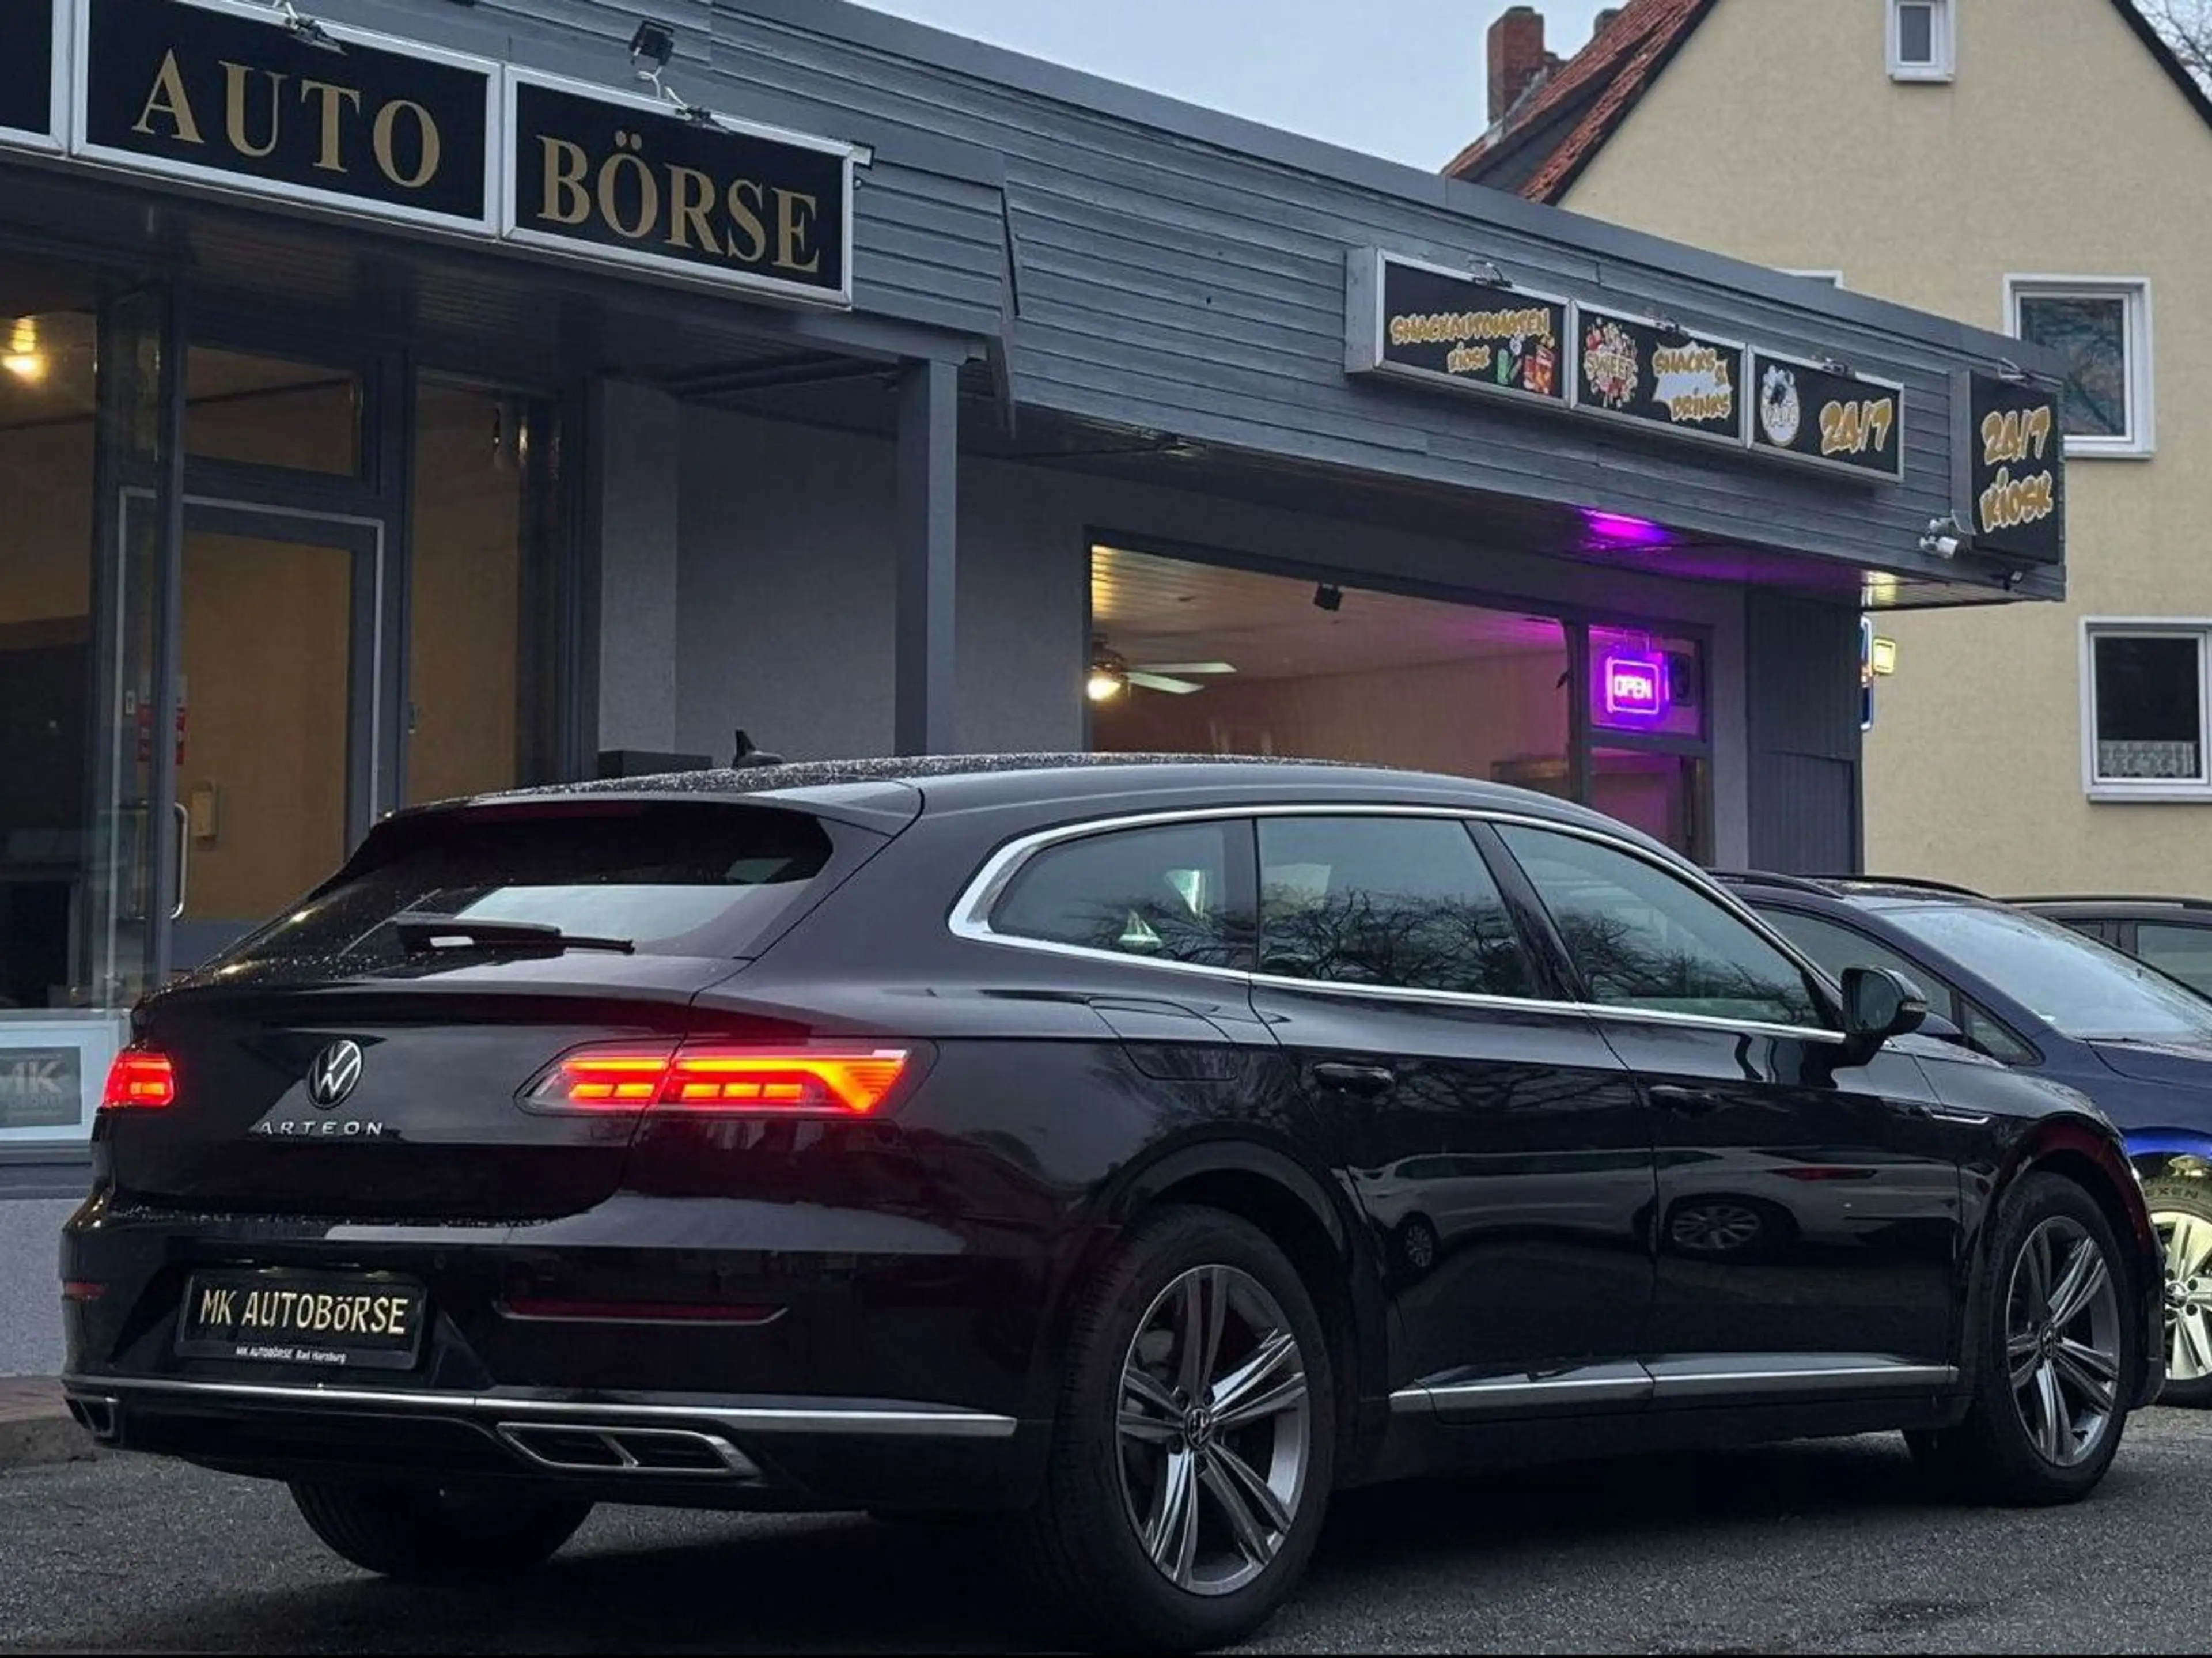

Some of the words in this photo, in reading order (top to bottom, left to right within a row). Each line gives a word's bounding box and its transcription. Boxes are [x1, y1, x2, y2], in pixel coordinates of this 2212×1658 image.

[131, 48, 441, 188] AUTO
[536, 129, 819, 273] BÖRSE
[1652, 347, 1717, 377] SNACKS
[1819, 398, 1892, 455] 24/7
[1982, 406, 2050, 464] 24/7
[1979, 466, 2053, 532] KIOSK
[1613, 674, 1652, 700] OPEN
[260, 1121, 383, 1135] ARTEON
[199, 1289, 237, 1326] MK
[236, 1345, 248, 1356] MK
[296, 1349, 311, 1360] Bad
